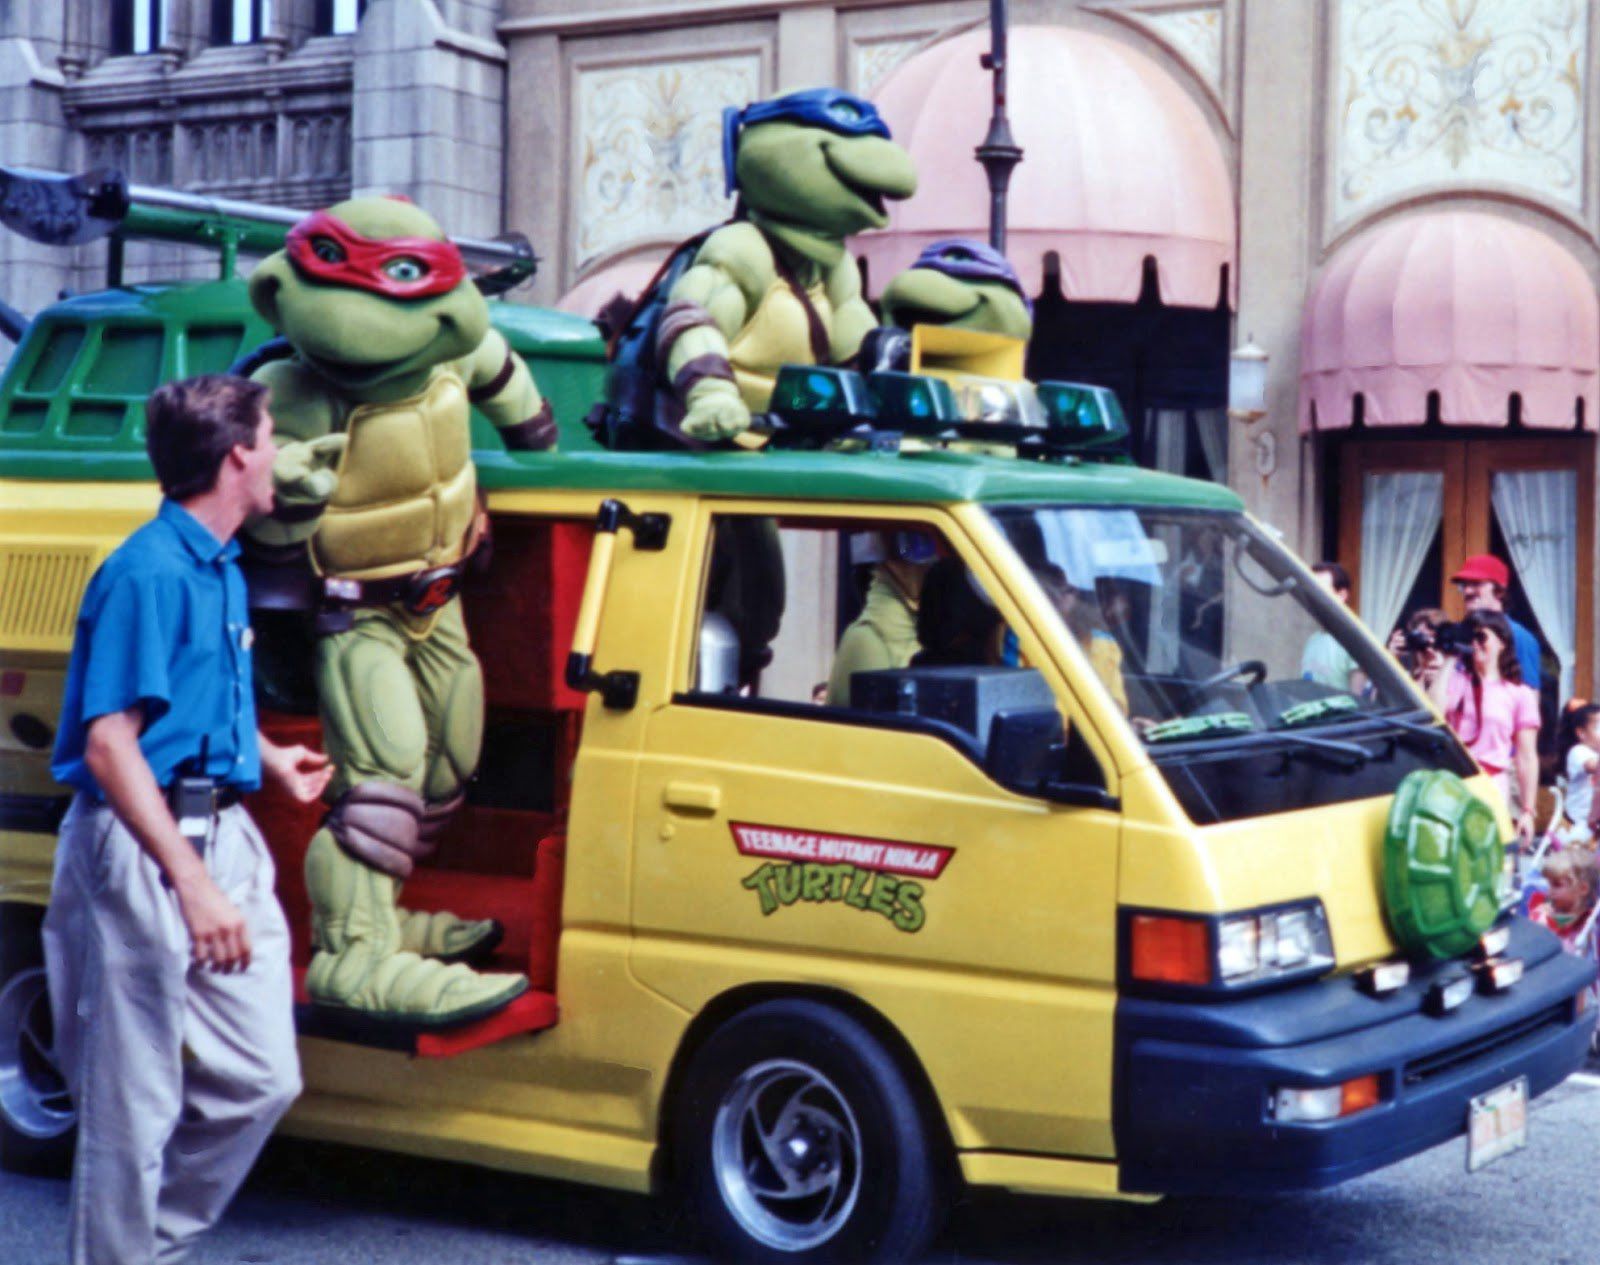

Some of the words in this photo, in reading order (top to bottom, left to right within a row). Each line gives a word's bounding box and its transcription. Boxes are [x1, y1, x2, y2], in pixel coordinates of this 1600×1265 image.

[737, 828, 816, 857] TEENAGE
[819, 838, 884, 865] MUTANT
[884, 847, 939, 871] NINJA
[741, 862, 926, 933] TURTLES
